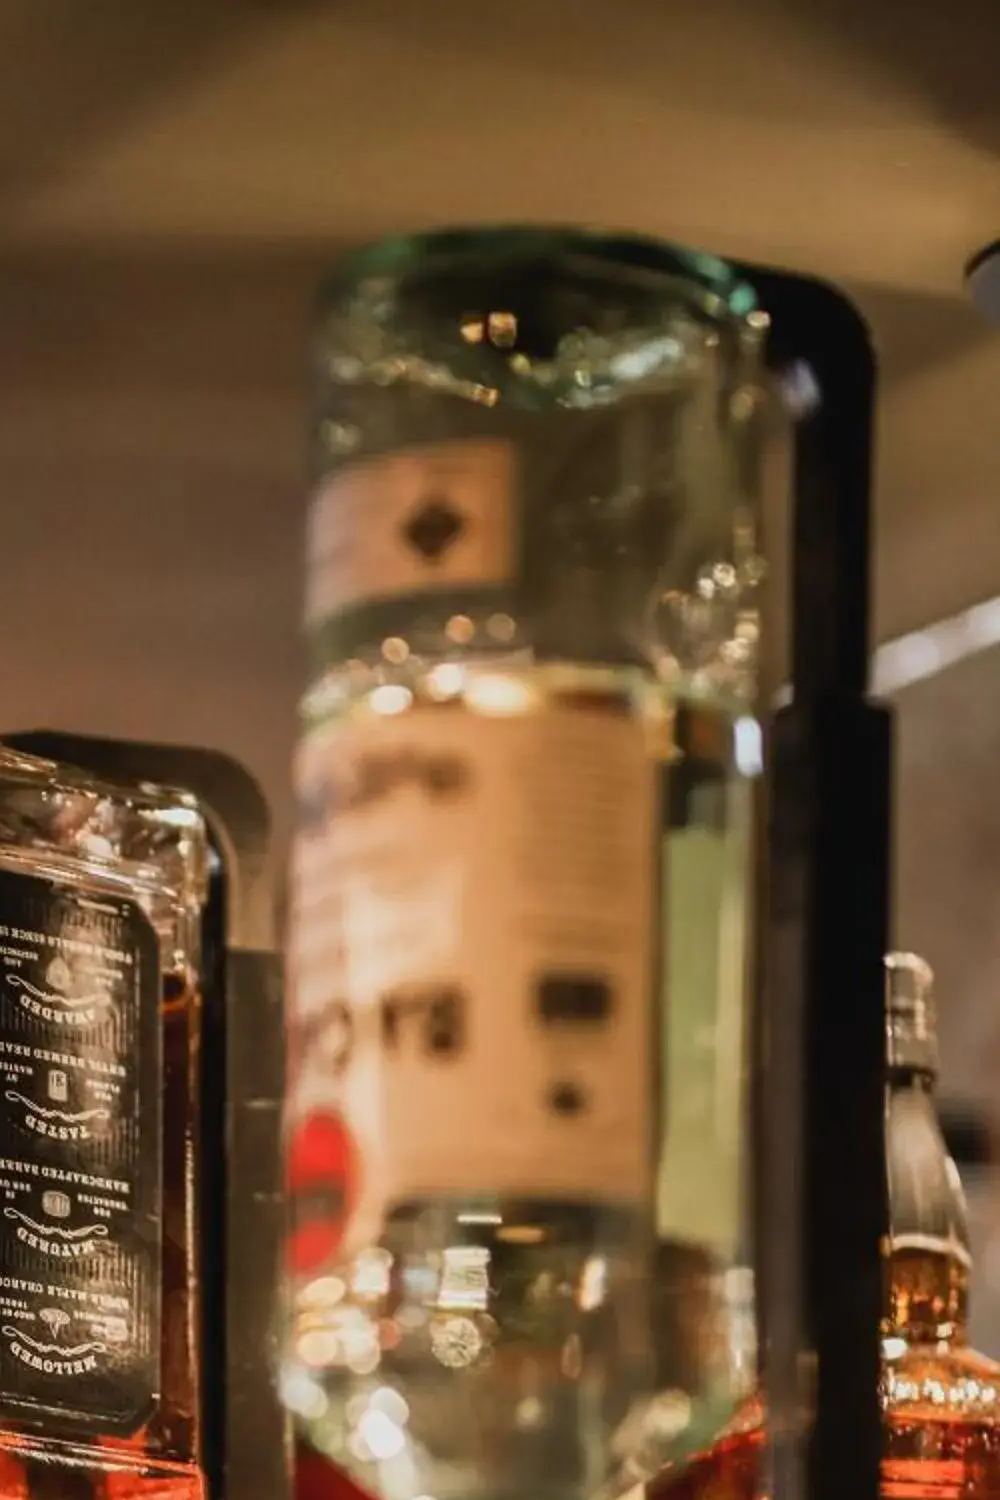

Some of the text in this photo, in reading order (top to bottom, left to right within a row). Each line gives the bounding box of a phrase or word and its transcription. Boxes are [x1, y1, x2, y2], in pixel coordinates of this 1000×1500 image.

[11, 928, 46, 944] SINCE
[25, 1115, 90, 1140] TASTED
[41, 1167, 130, 1194] HANDCRAFTED
[17, 1227, 96, 1257] MATURED
[47, 1285, 87, 1301] MAPLE
[10, 1341, 97, 1375] MELLOWED
